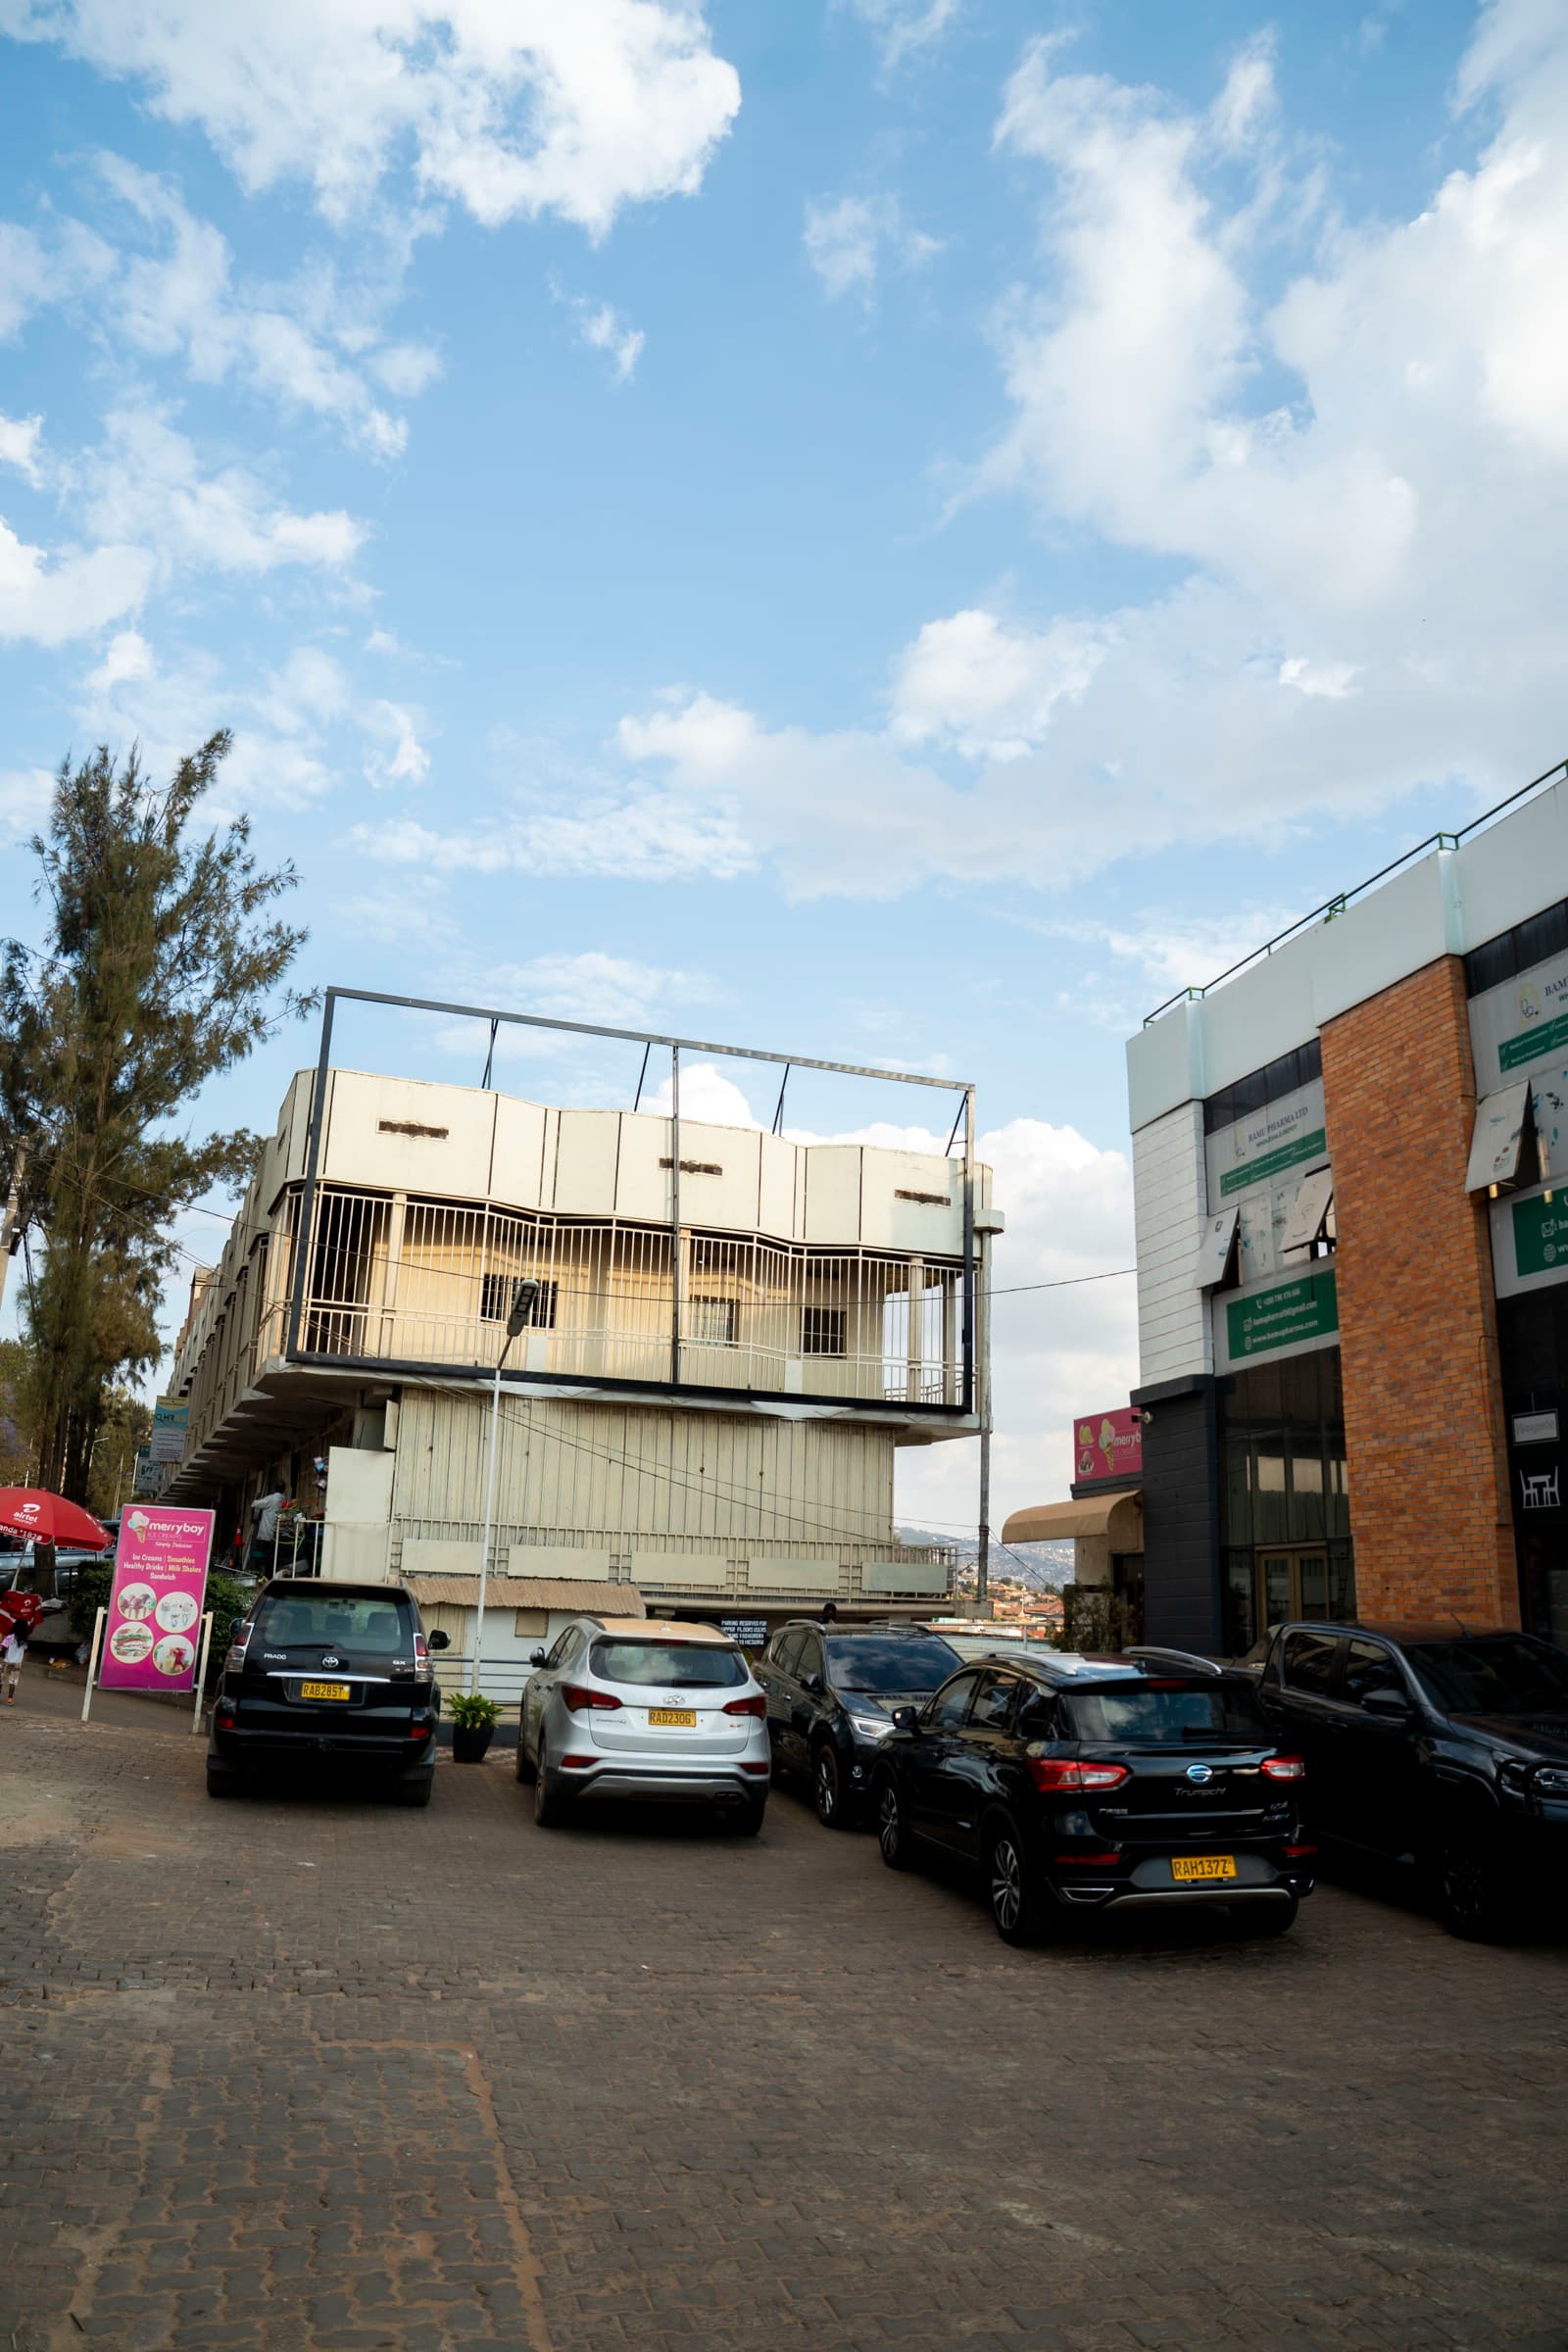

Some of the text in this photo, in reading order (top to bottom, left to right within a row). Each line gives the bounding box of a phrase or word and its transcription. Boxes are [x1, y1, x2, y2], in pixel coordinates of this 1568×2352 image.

[1544, 975, 1568, 997] BAM
[1267, 1114, 1294, 1134] PHARMA
[1295, 1106, 1308, 1120] LTD
[1114, 1430, 1142, 1447] merryb
[13, 1511, 38, 1523] airtel
[149, 1522, 204, 1536] merryboy
[141, 1553, 163, 1562] Creams
[167, 1555, 195, 1564] Smoothies
[123, 1562, 144, 1571] Healthy
[150, 1572, 176, 1581] Sandwich
[303, 1684, 344, 1698] RAB285T
[650, 1711, 691, 1725] RAD230G
[1174, 1858, 1230, 1878] RAH137Z
